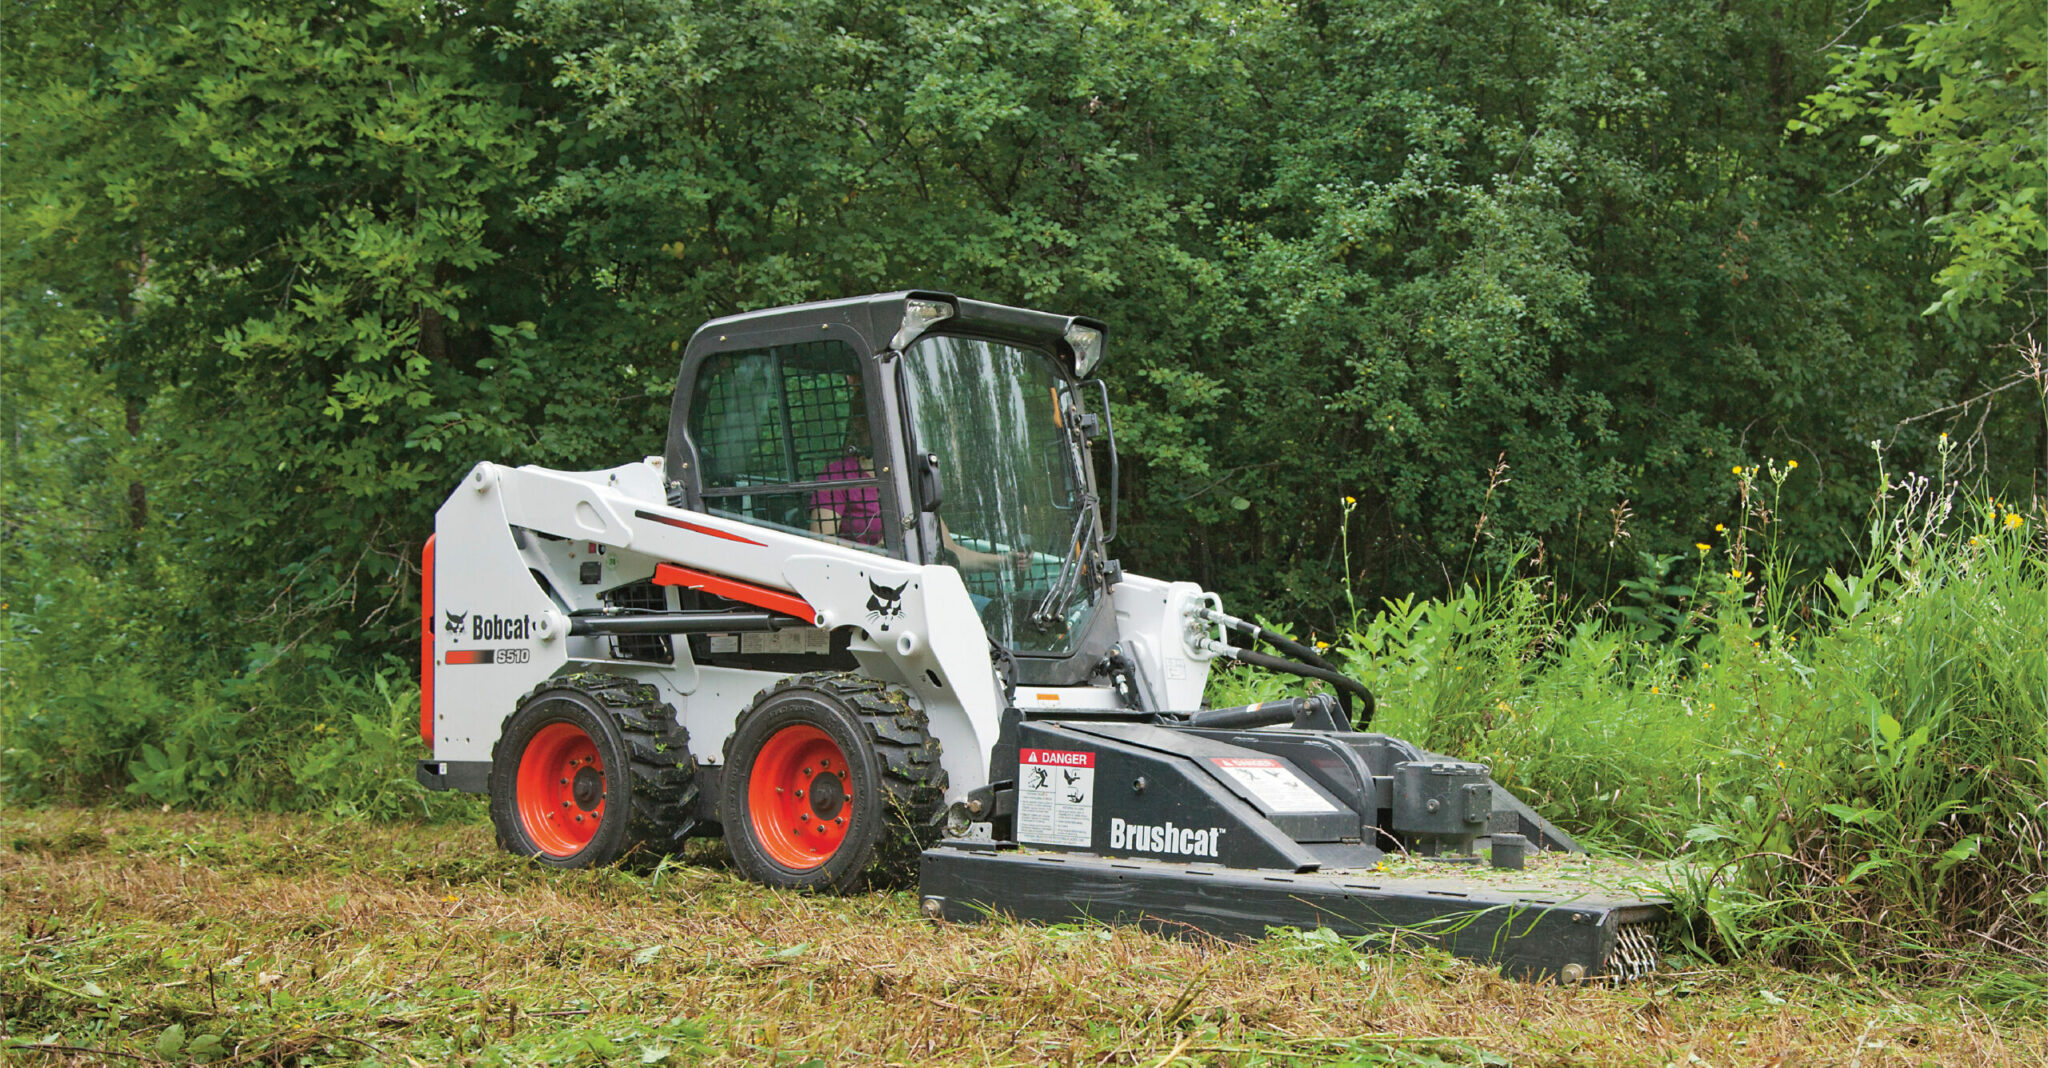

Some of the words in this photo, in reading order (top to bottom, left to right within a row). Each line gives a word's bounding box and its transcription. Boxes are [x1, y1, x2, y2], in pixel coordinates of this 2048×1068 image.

[473, 614, 530, 640] Bobcat
[496, 648, 530, 664] S510
[1042, 752, 1087, 765] DANGER
